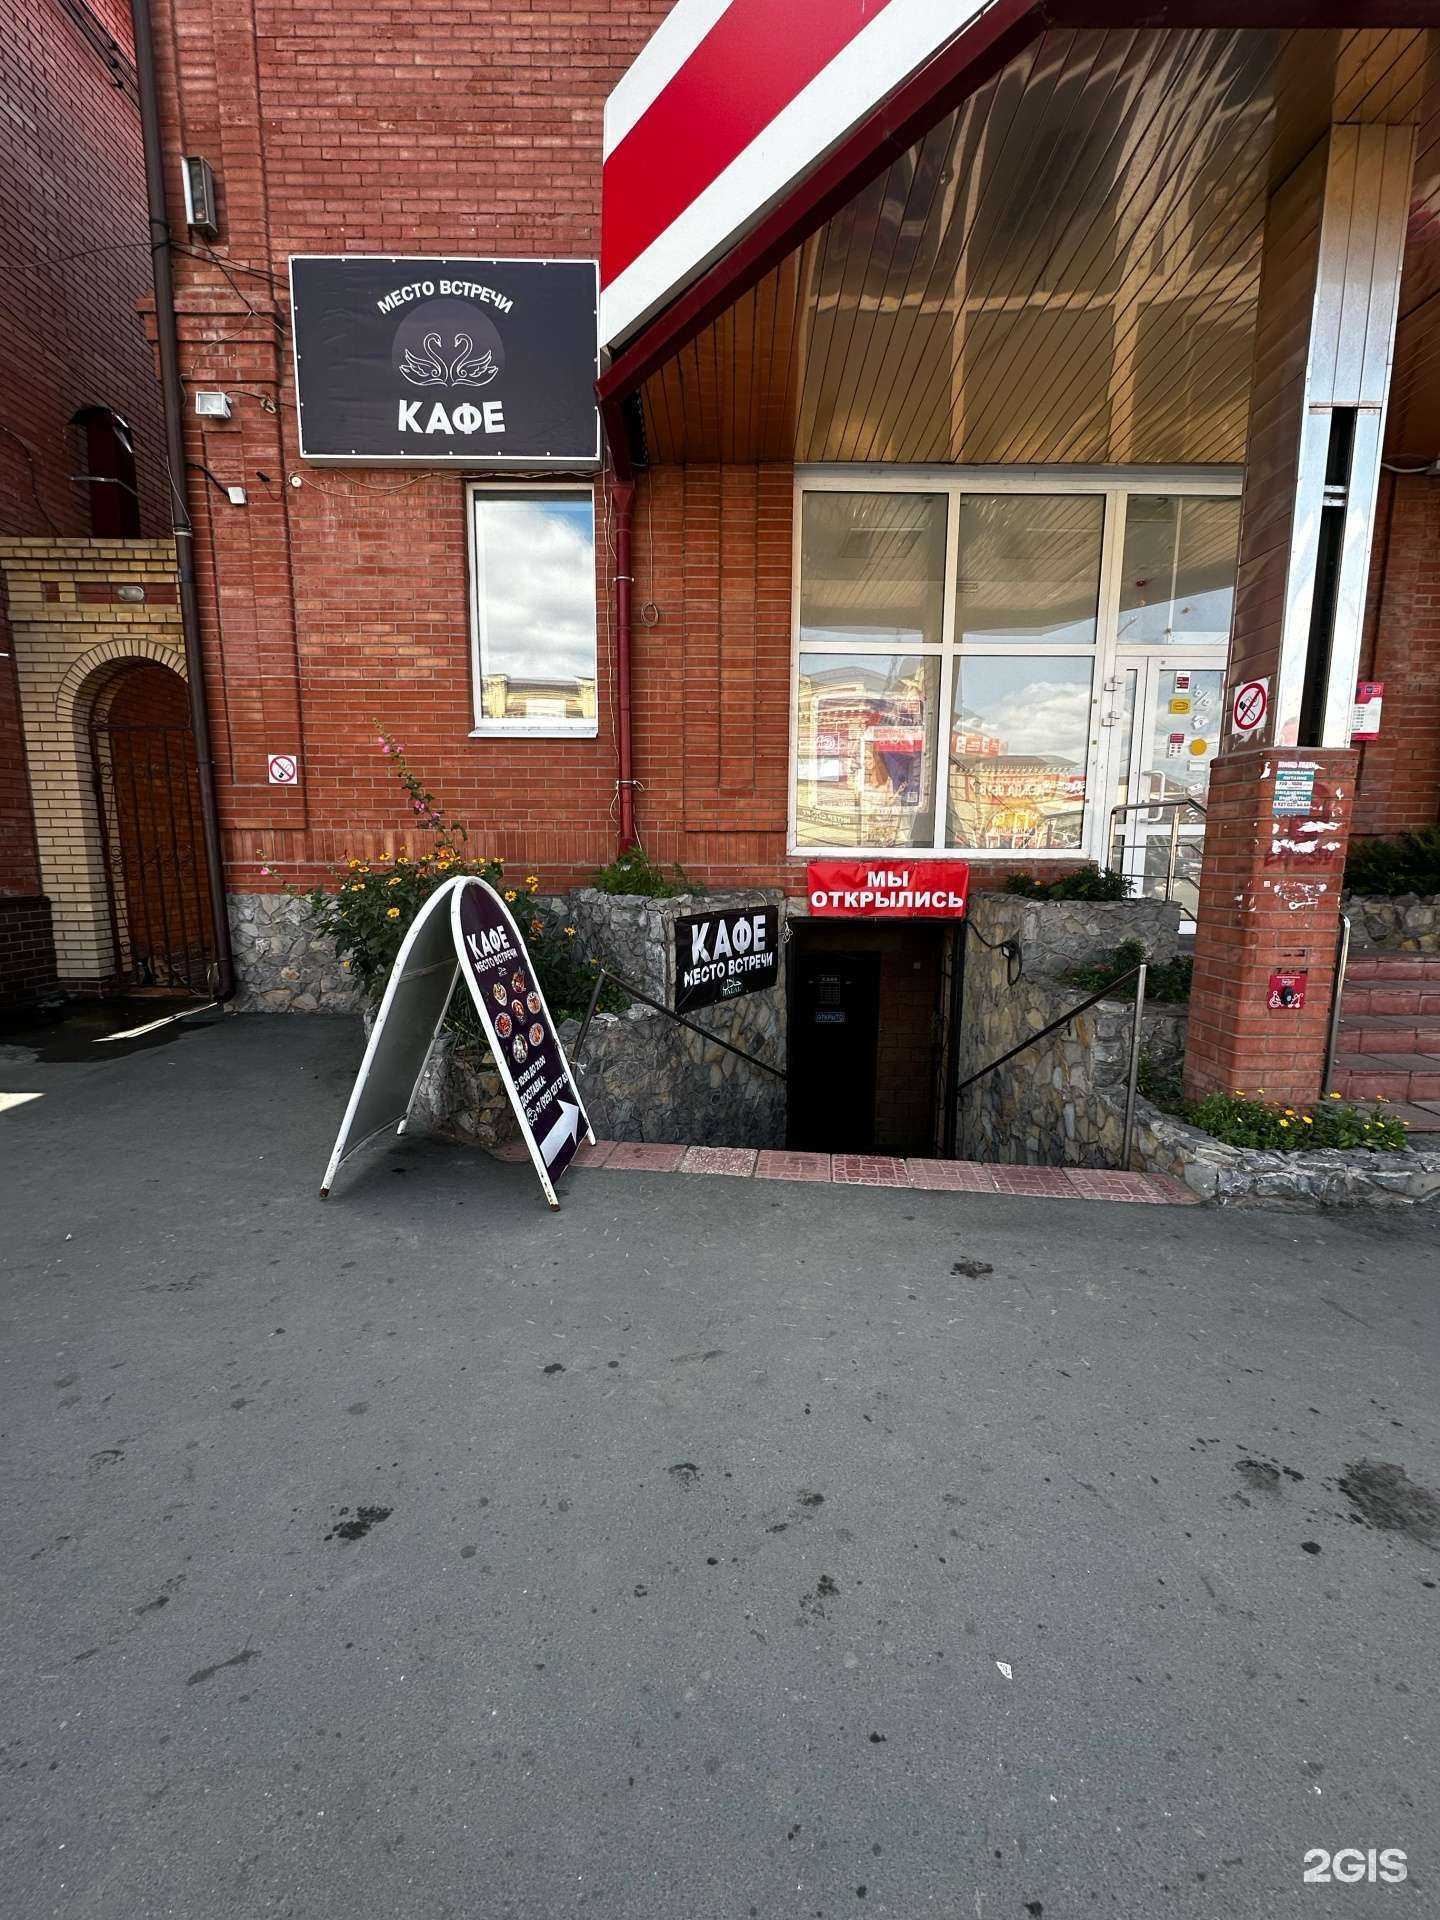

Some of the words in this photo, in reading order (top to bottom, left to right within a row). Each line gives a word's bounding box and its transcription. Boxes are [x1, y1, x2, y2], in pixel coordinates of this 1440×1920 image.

[377, 281, 435, 315] МЕСТО
[439, 280, 514, 314] ВСТРЕЧИ
[398, 399, 506, 435] КАФЕ
[867, 870, 909, 888] МЫ
[811, 890, 964, 908] ОТКРЫЛИСЬ
[466, 925, 510, 960] КАФЕ
[691, 914, 766, 966] КАФЕ
[474, 957, 496, 974] МЕСТО
[493, 948, 518, 965] ВСТРЕЧИ
[684, 962, 726, 988] МЕСТО
[728, 952, 773, 976] ВСТРЕЧИ
